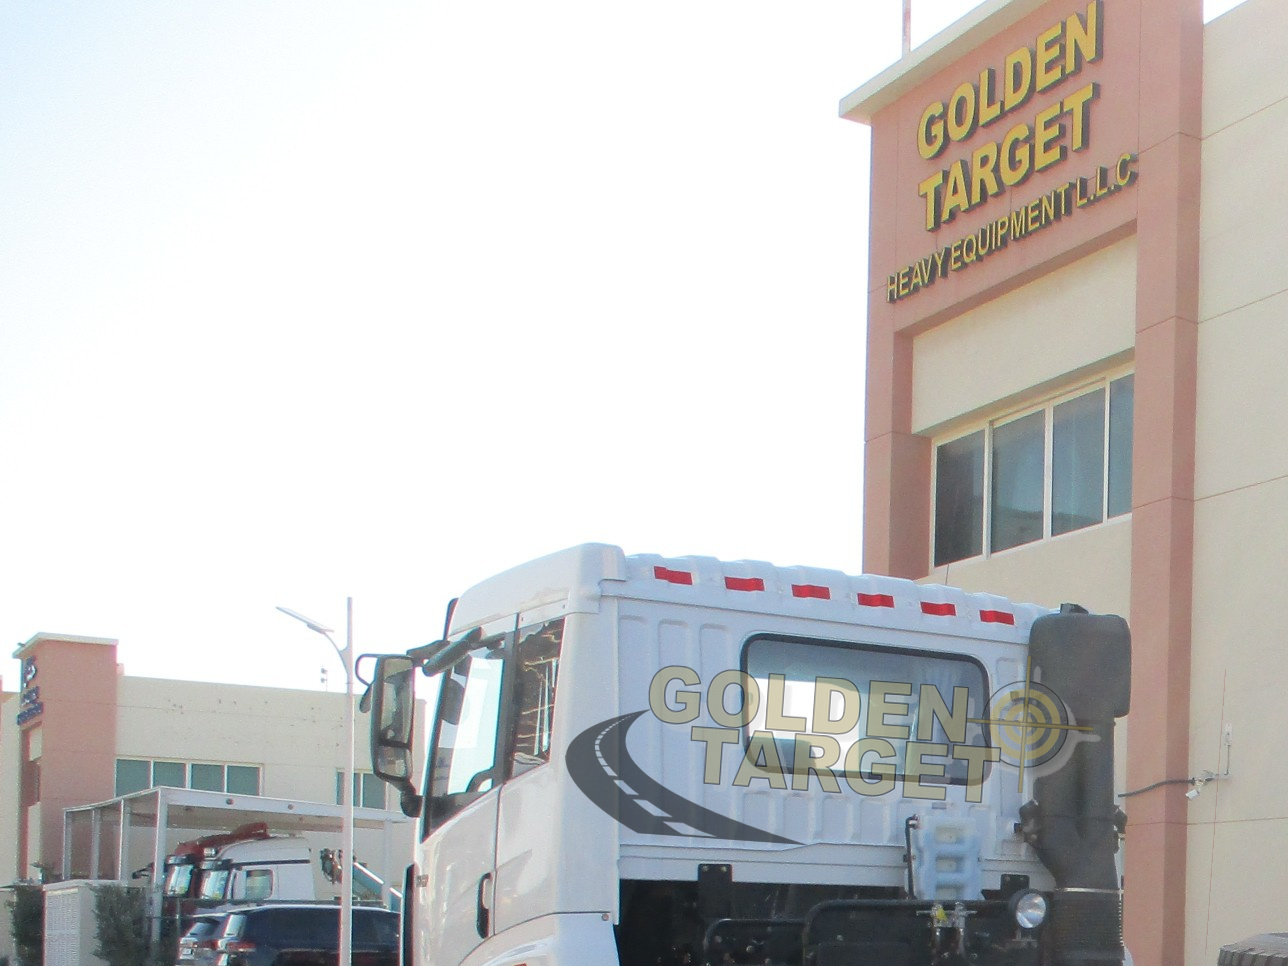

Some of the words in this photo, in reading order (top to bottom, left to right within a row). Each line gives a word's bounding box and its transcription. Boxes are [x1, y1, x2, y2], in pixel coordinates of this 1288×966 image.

[917, 0, 1098, 160] GOLDEN
[886, 248, 946, 303] HEAVY
[950, 182, 1071, 272] EQUIPMENT
[1075, 153, 1133, 208] L.L.C
[917, 82, 1096, 232] TARGET
